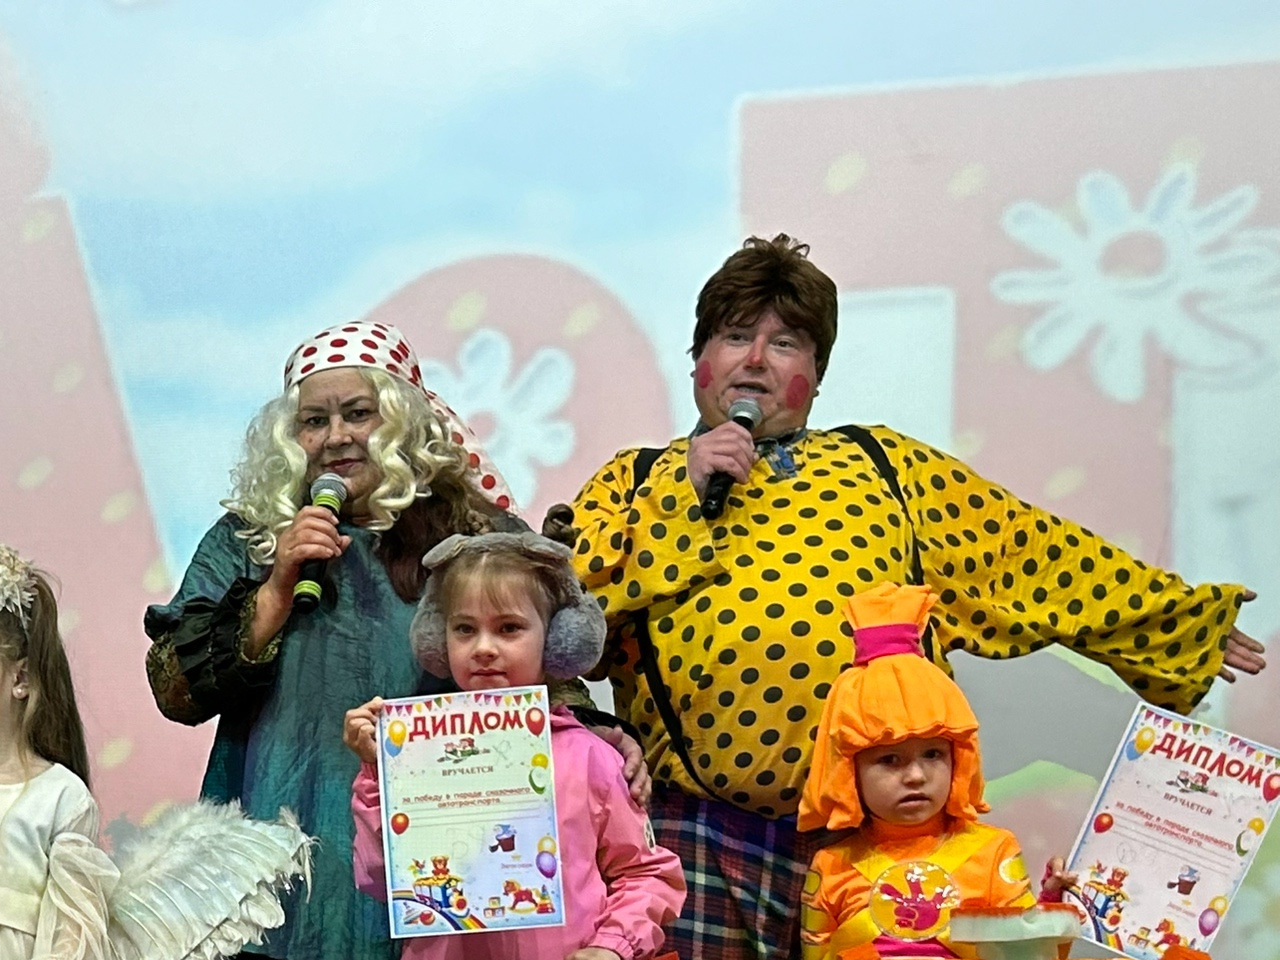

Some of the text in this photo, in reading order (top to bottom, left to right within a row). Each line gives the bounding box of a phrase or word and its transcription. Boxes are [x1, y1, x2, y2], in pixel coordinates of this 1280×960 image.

[408, 710, 524, 742] ДИПЛОМ
[441, 765, 494, 777] ВРУЧАЕТСЯ
[1151, 731, 1262, 788] ДИПЛОМ
[414, 794, 443, 803] победу
[453, 791, 482, 800] параде
[485, 786, 531, 797] сказочного
[1163, 792, 1213, 816] ВРУЧАЕТСЯ
